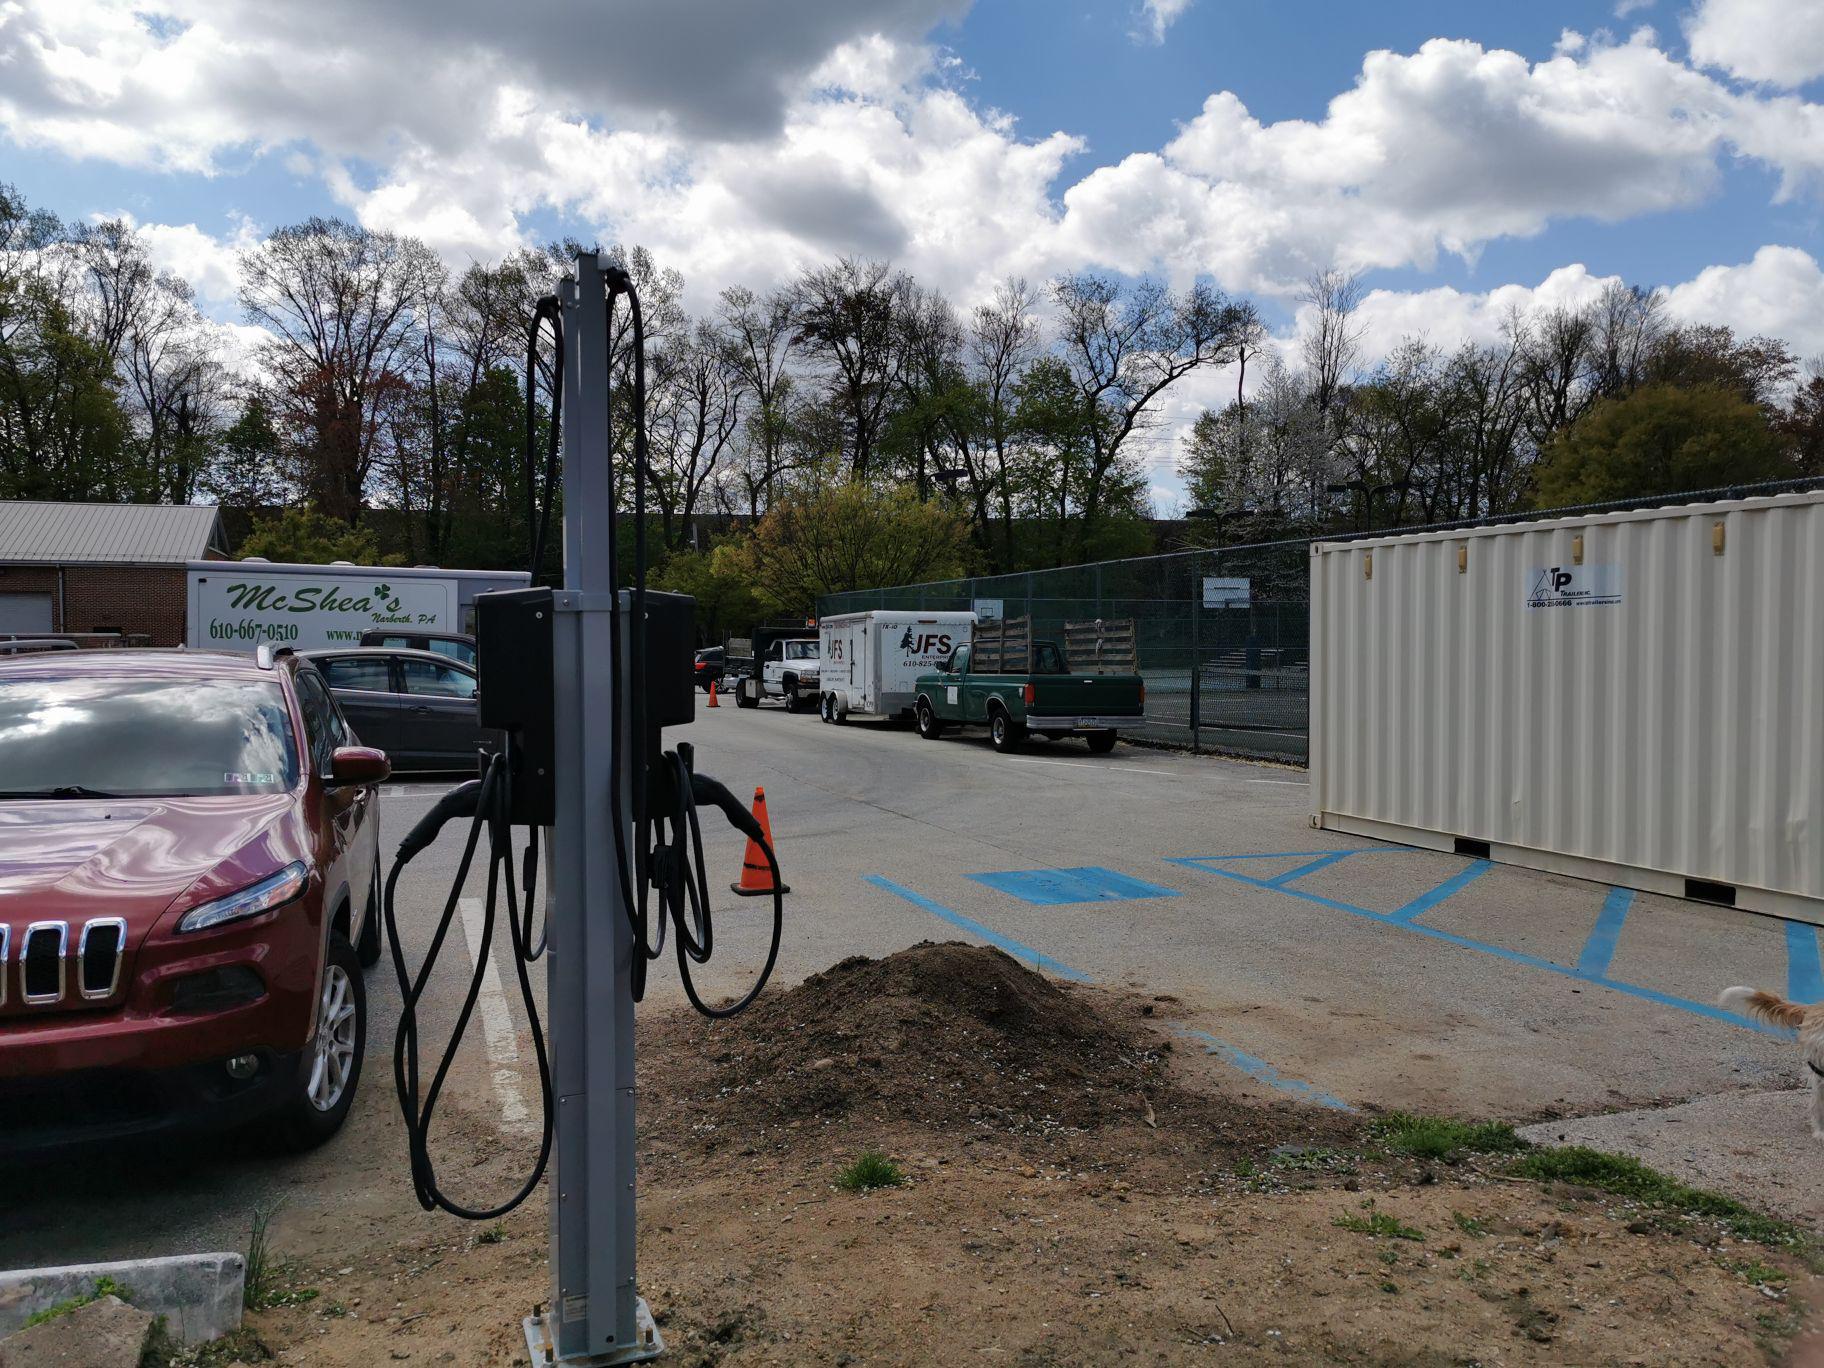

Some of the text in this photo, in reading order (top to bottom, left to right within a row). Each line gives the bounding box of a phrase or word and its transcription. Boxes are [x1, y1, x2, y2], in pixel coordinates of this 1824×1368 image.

[226, 583, 402, 613] McShea's
[418, 613, 437, 624] PA
[210, 617, 299, 644] 610-667-0510
[830, 639, 843, 660] JFS
[911, 634, 952, 655] JFS
